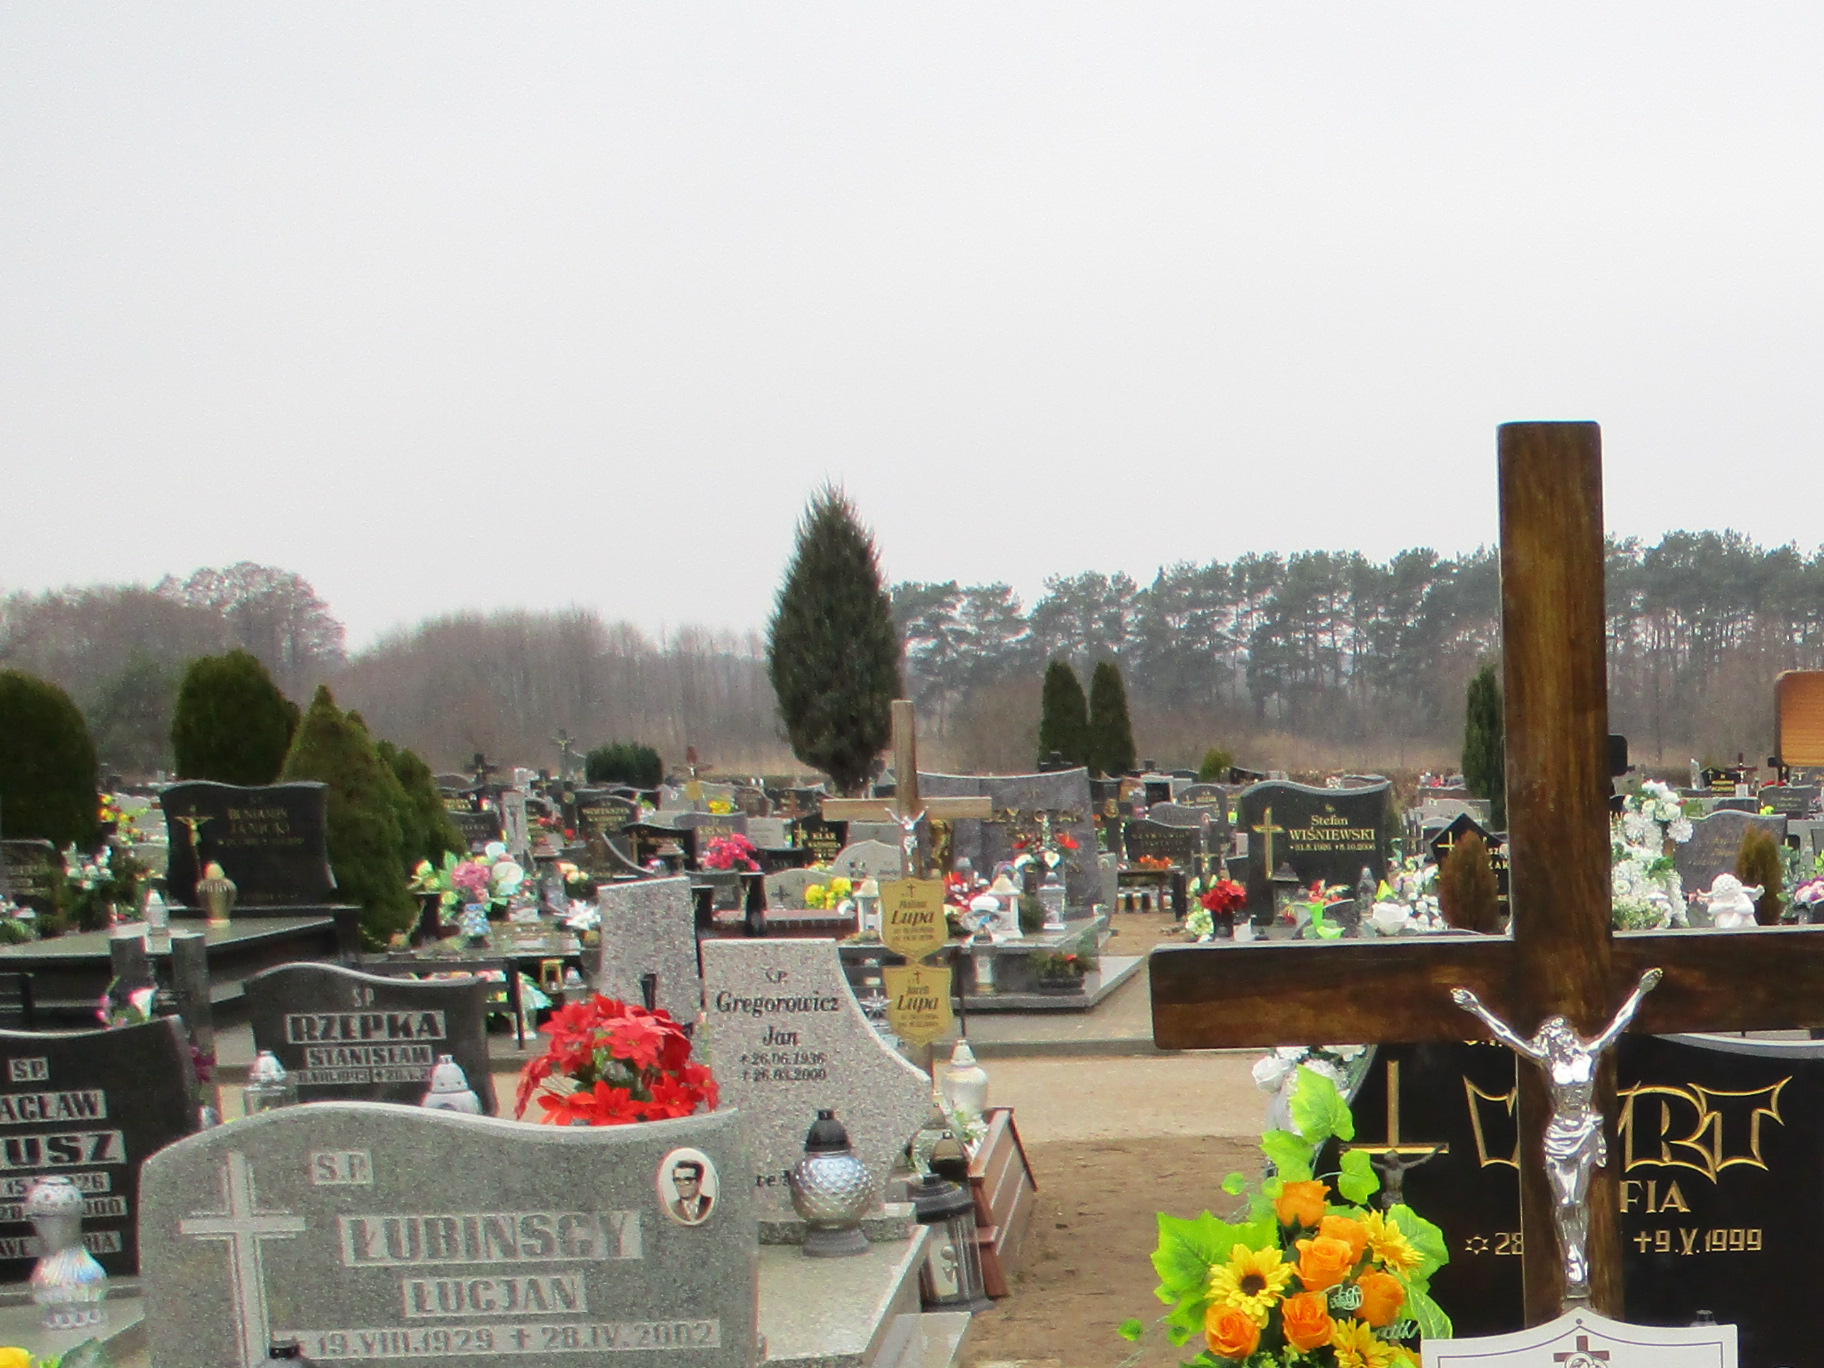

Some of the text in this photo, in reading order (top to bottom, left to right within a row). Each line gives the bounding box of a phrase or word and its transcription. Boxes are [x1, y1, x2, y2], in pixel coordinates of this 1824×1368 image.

[1311, 814, 1348, 826] Stefan
[1289, 827, 1376, 840] WIŚNIEWSKI
[891, 910, 935, 927] Lupa
[716, 990, 841, 1018] Gregorowicz
[896, 995, 939, 1013] Lupa
[290, 1012, 442, 1042] RZEPKA
[762, 1026, 798, 1046] Jan
[5, 1134, 119, 1166] USZ
[1619, 1180, 1691, 1213] FIA
[409, 1277, 579, 1314] LUCJAN
